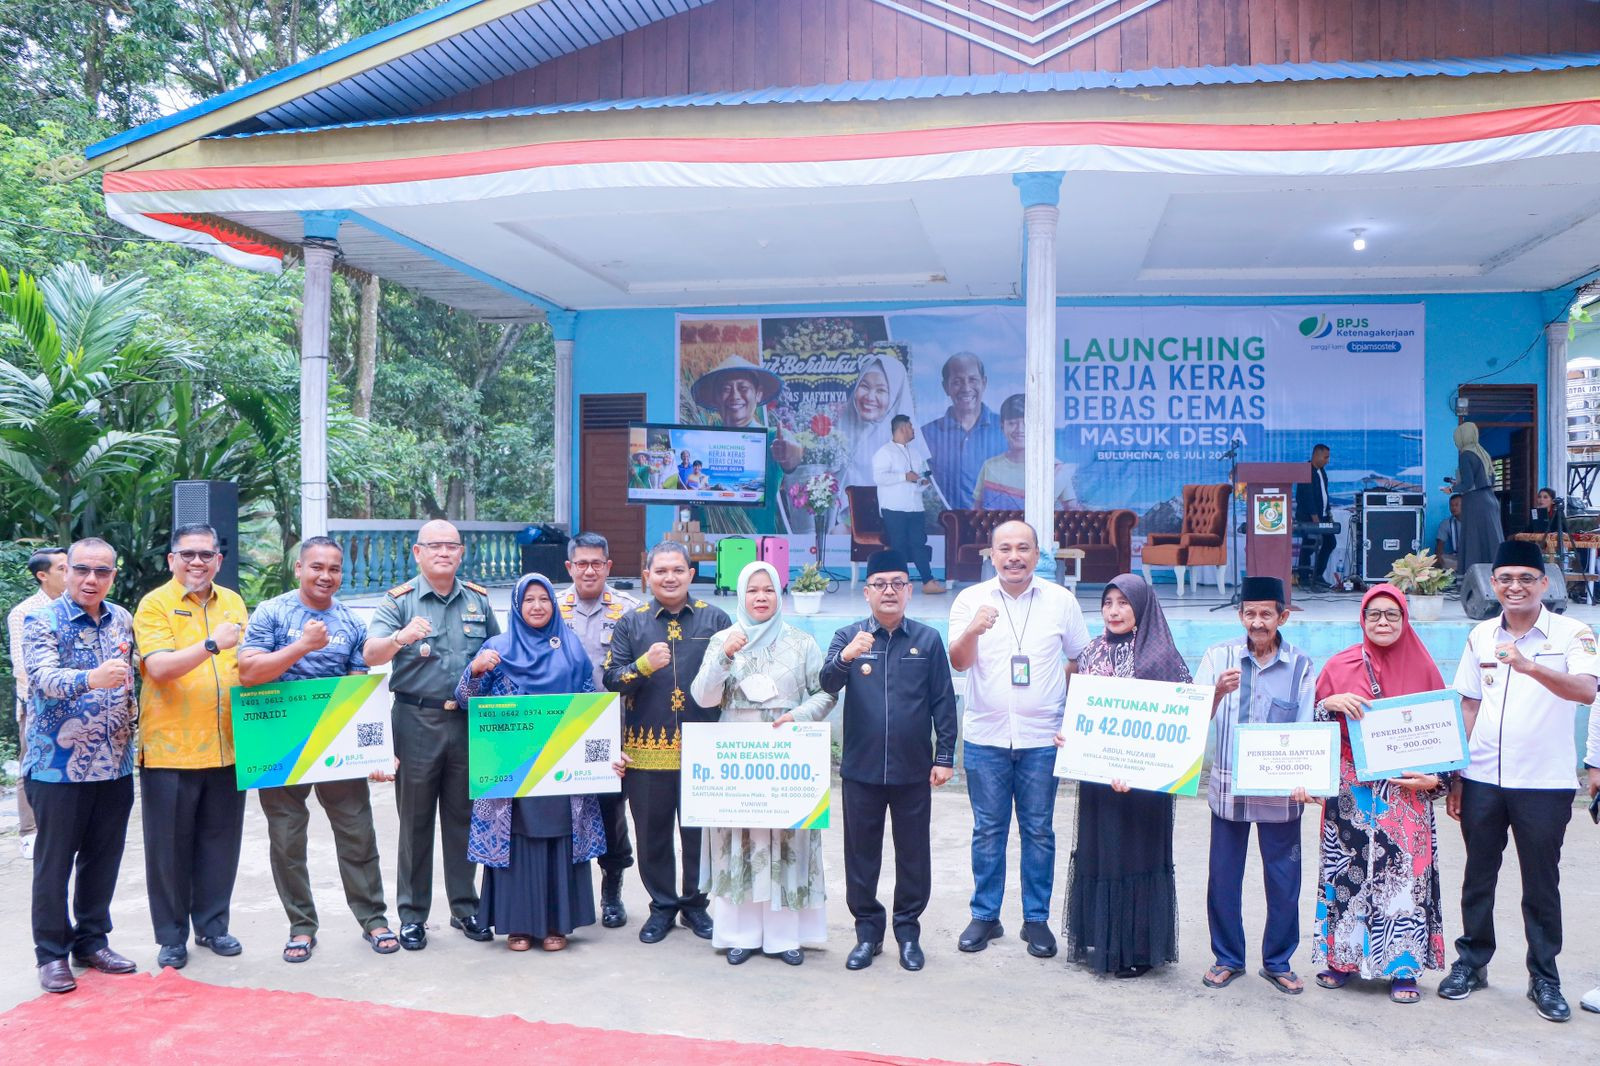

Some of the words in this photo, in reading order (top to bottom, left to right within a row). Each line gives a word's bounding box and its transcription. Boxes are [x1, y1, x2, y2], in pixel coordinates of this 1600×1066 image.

[1337, 319, 1368, 327] BPJS
[1337, 329, 1414, 338] Ketenagakerjaan
[1064, 337, 1265, 362] LAUNCHING
[1352, 343, 1396, 352] bpjamsostek
[1064, 366, 1156, 391] KERJA
[1170, 364, 1265, 390] KERAS
[1064, 396, 1155, 420] BEBAS
[1168, 395, 1265, 420] CEMAS
[1080, 427, 1171, 446] MASUK
[1180, 426, 1248, 446] DESA
[1098, 451, 1163, 460] BULUHCINA,
[1166, 451, 1179, 460] 06
[1183, 451, 1205, 460] JULI
[1087, 696, 1159, 712] SANTUNAN
[1162, 704, 1189, 716] JKM
[243, 710, 286, 721] JUNAIDI
[480, 723, 534, 732] NURMATIAS
[1076, 714, 1093, 735] Rp
[1371, 727, 1412, 738] PENERIMA
[1415, 721, 1452, 732] BANTUAN
[716, 741, 769, 749] SANTUNAN
[772, 741, 791, 749] JKM
[247, 763, 284, 774] 07-2023
[692, 764, 715, 782] Rp.
[720, 763, 819, 782] 90.000.000,-
[479, 775, 513, 783] 07-2023
